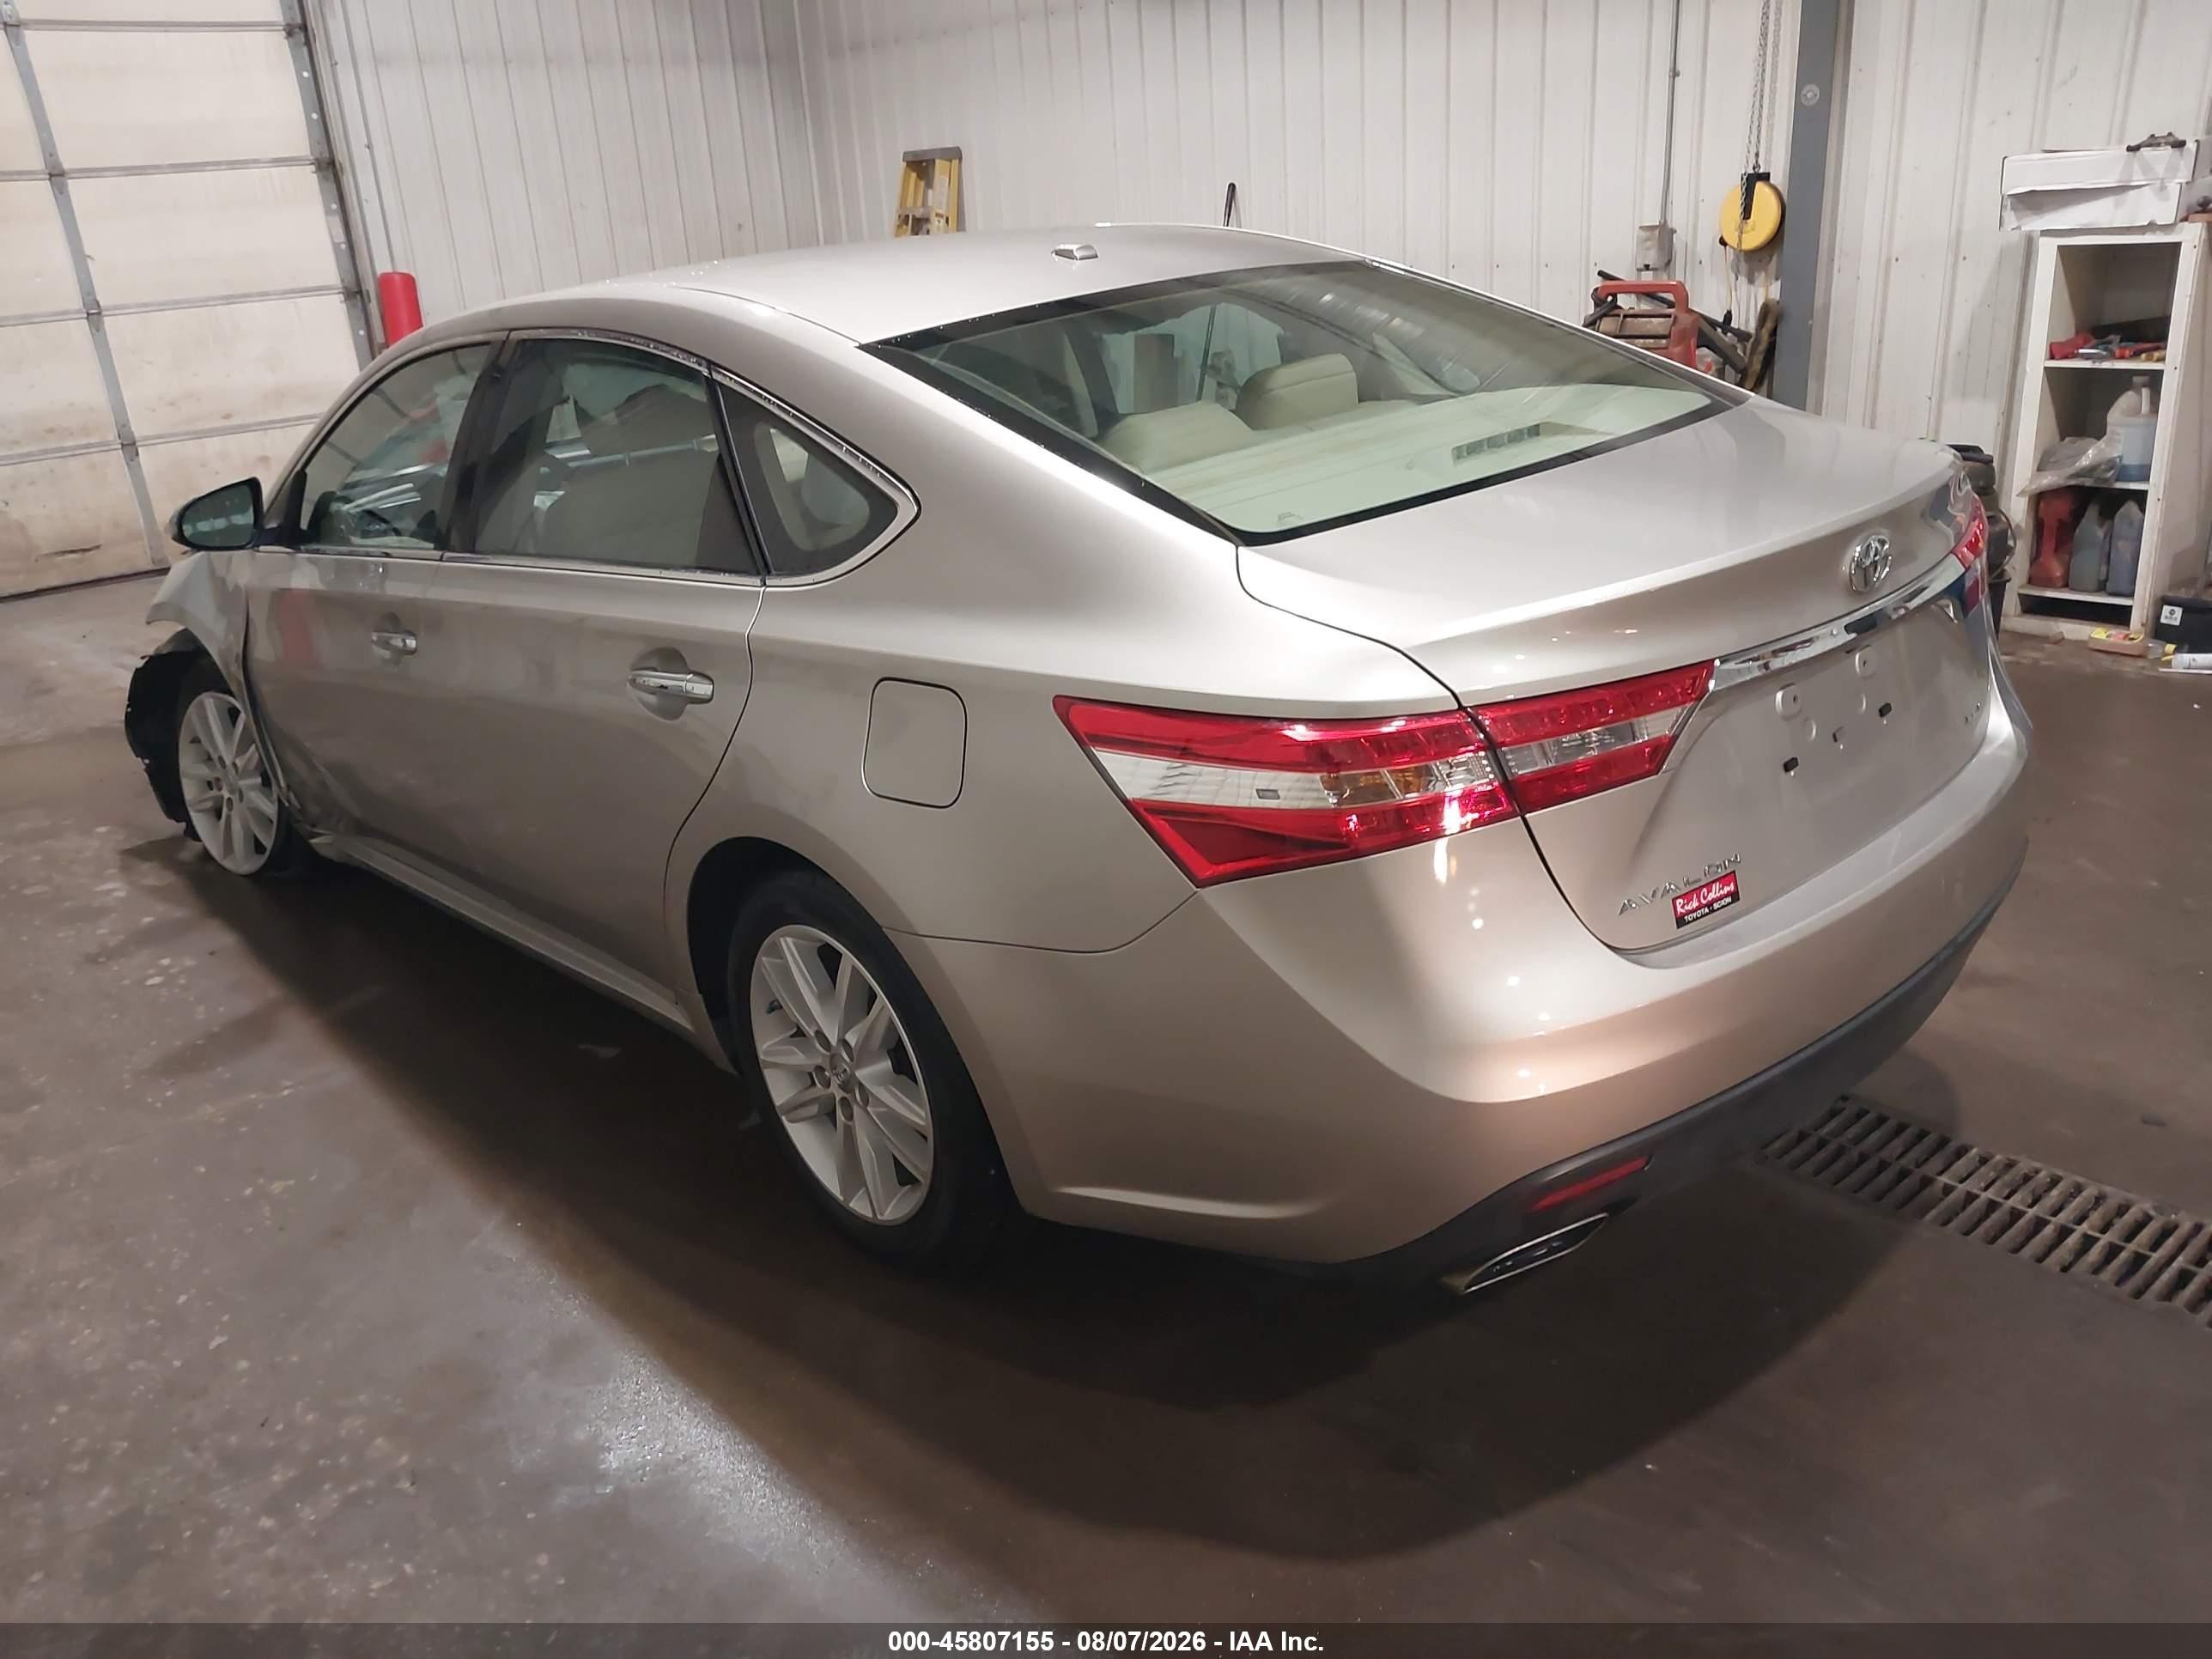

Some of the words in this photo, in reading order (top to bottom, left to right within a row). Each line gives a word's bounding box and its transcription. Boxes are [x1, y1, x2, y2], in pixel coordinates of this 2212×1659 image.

[1618, 853, 1741, 915] AVALON
[1675, 893, 1699, 915] Rick
[1700, 881, 1735, 904] Collins
[1684, 907, 1710, 922] TOYOTA
[1713, 896, 1732, 909] SCION
